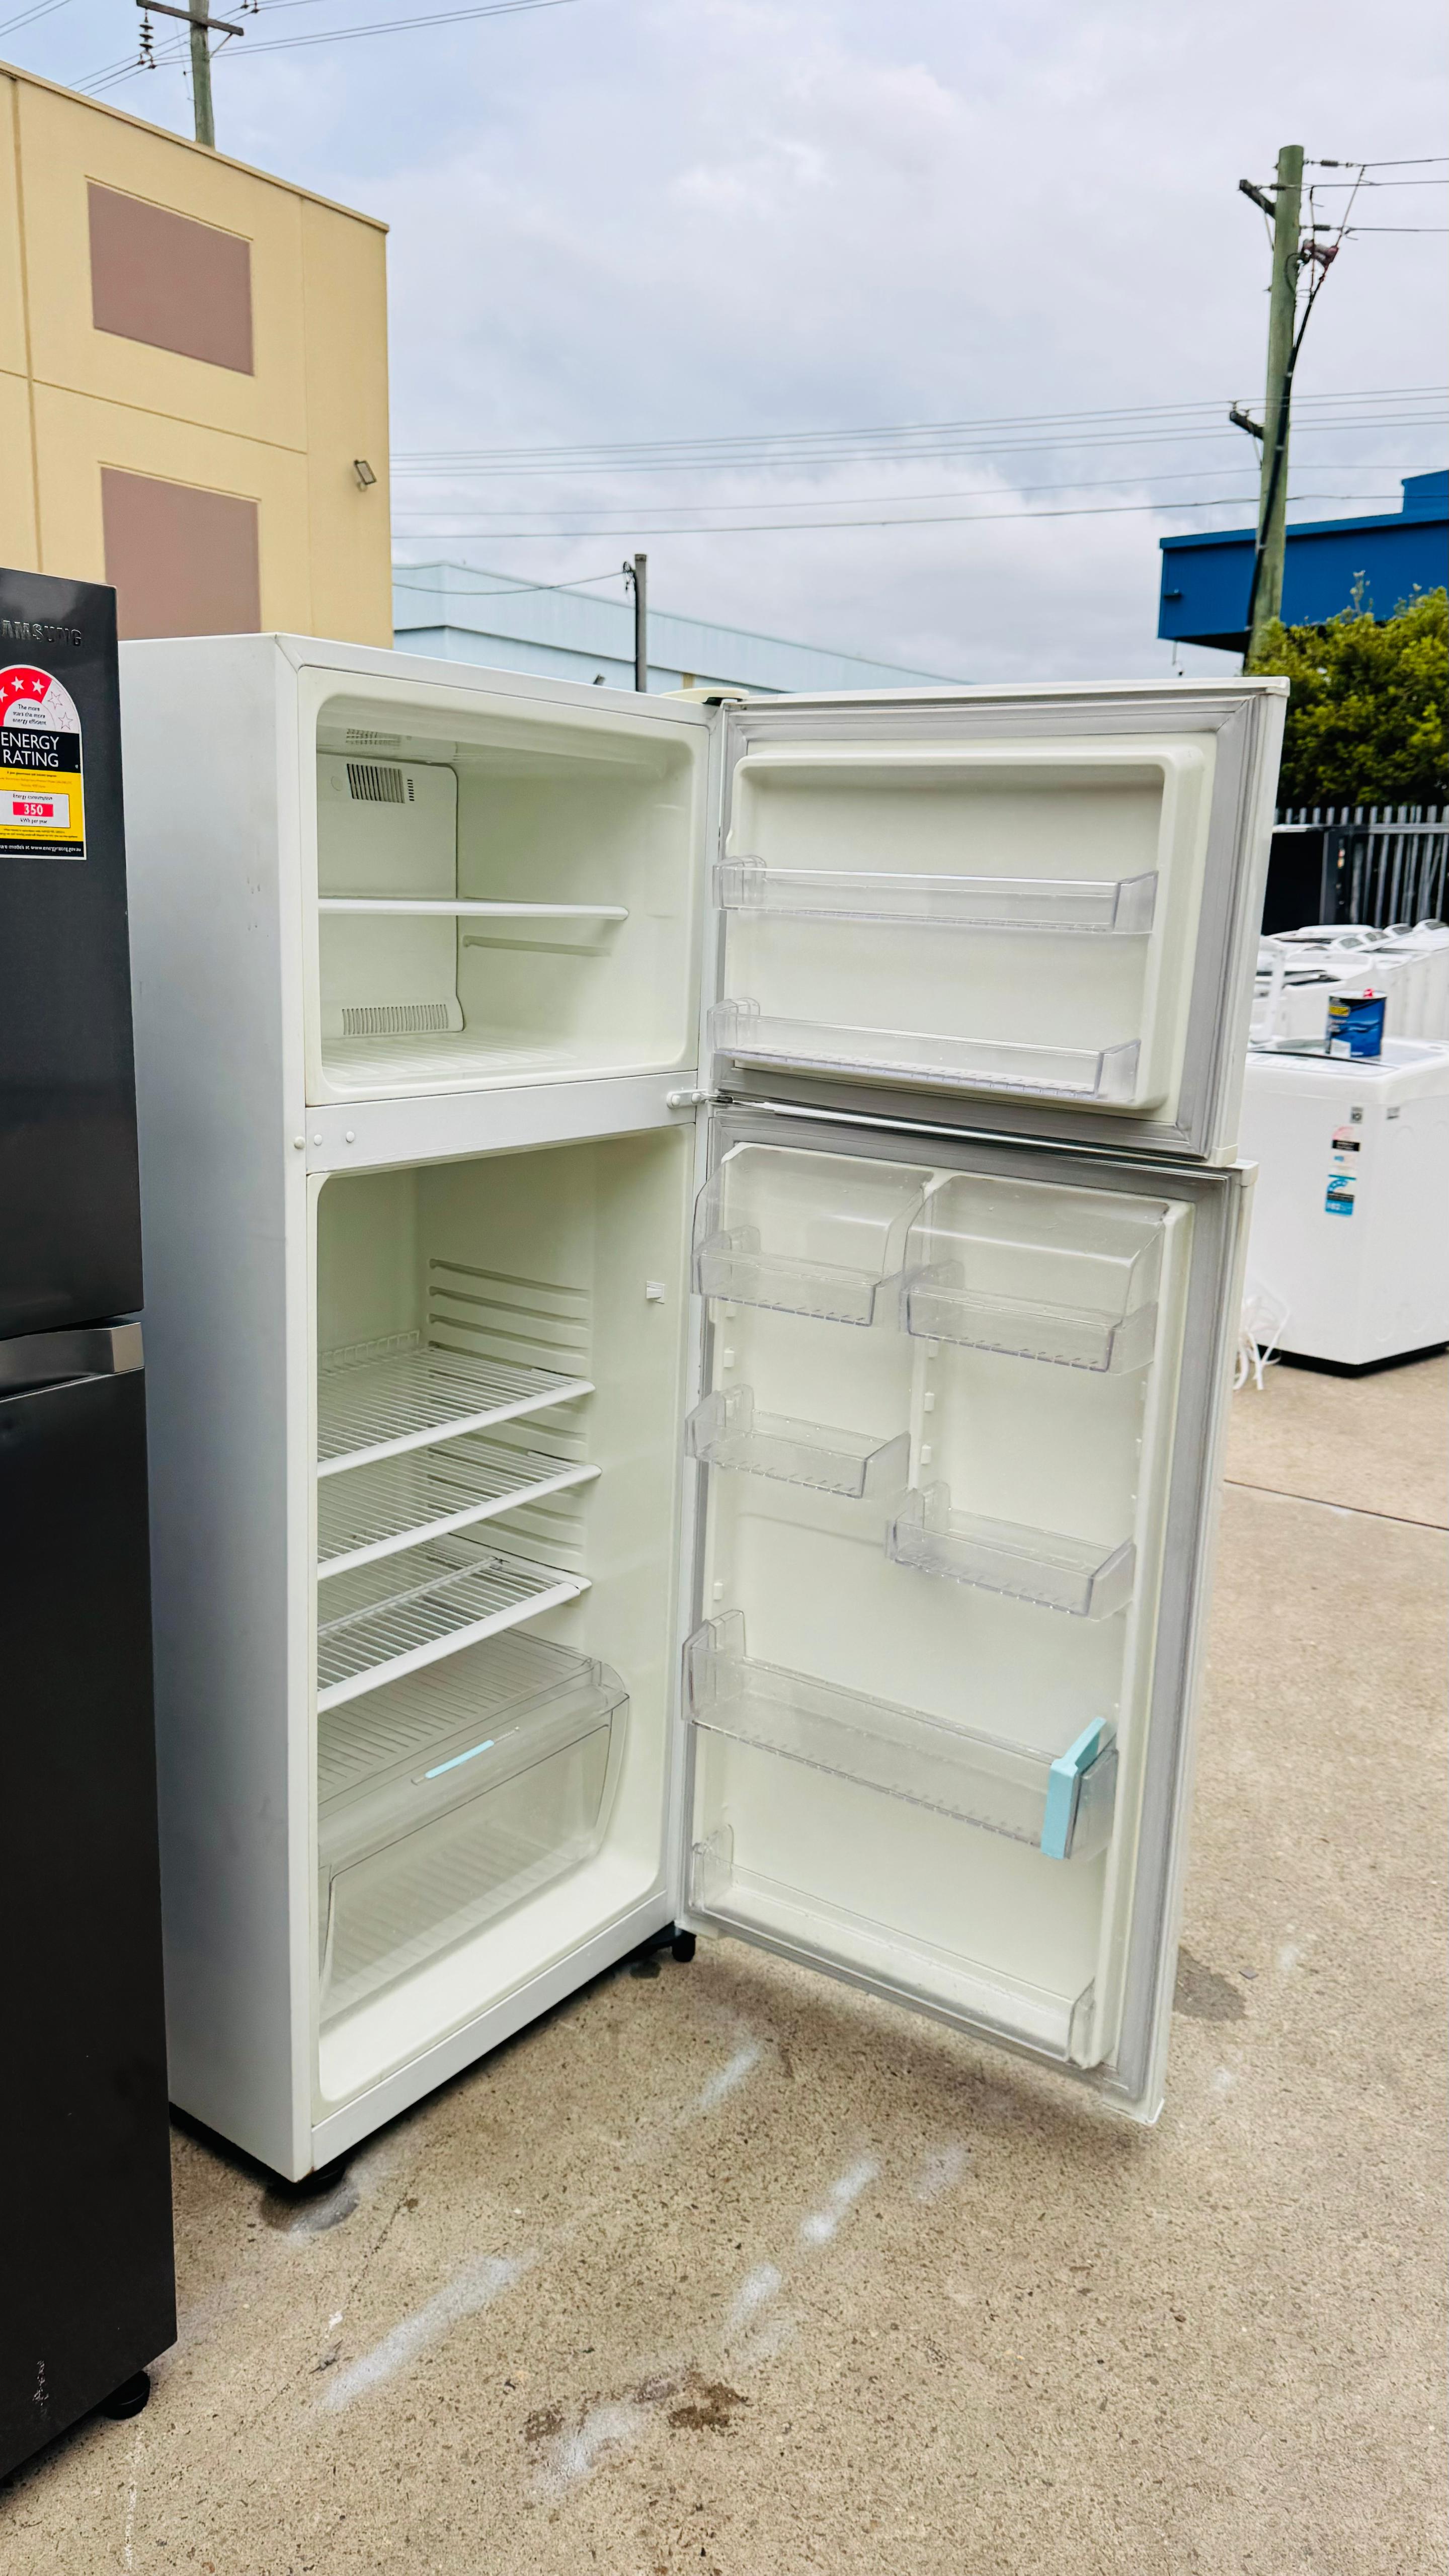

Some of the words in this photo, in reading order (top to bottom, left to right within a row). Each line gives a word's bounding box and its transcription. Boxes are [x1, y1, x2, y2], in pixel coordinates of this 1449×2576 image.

[1, 620, 82, 646] AMSUNG
[1, 732, 59, 750] ENERGY
[3, 749, 58, 767] RATING
[24, 803, 43, 816] 350
